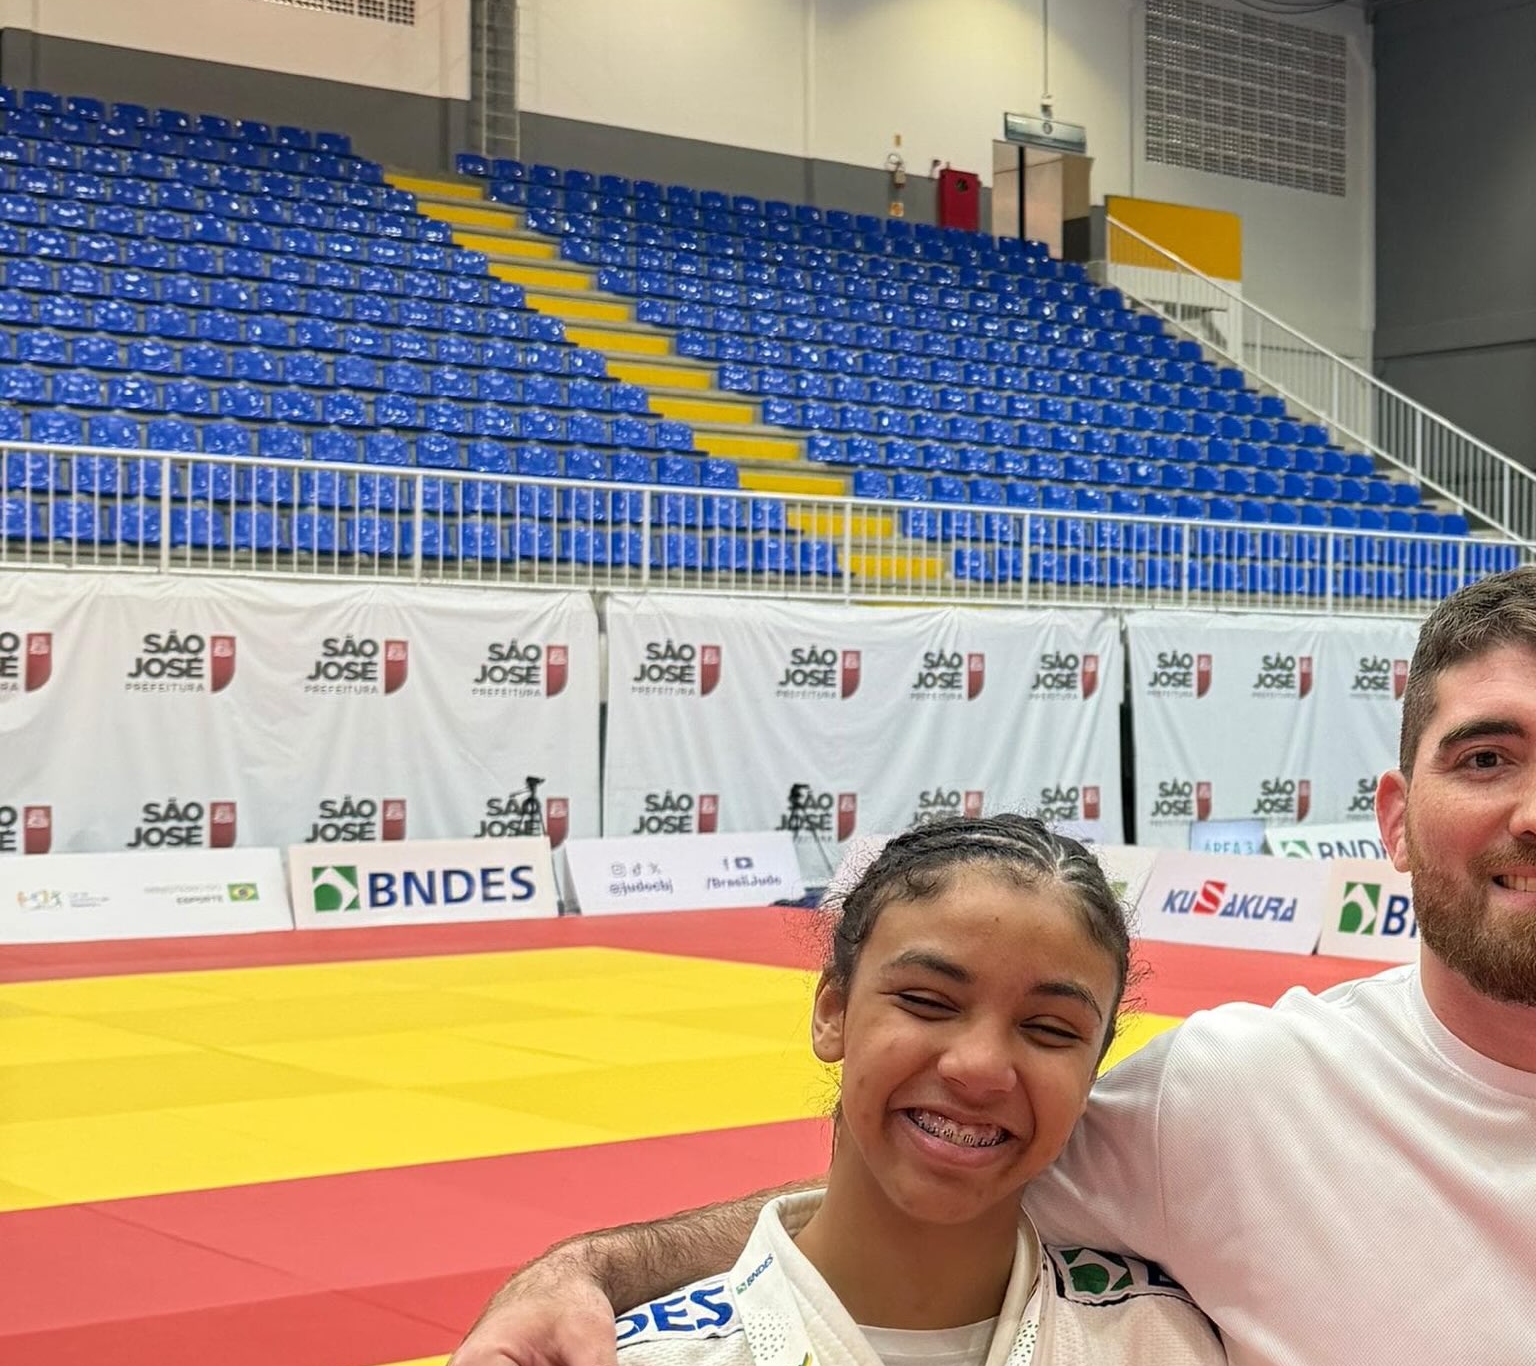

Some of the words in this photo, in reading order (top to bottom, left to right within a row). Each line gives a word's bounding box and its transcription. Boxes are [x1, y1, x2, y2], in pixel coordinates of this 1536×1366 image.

[143, 630, 206, 654] SÃO
[322, 635, 379, 658] SÃO
[488, 640, 542, 663] SÃO
[646, 639, 696, 662] SÃO
[127, 656, 204, 679] JOSÉ
[791, 645, 838, 667] SÃO
[307, 660, 378, 681] JOSÉ
[474, 664, 541, 685] JOSÉ
[143, 798, 204, 823] SÃO
[319, 796, 377, 819] SÃO
[645, 791, 695, 813] SÃO
[305, 822, 376, 843] JOSÉ
[632, 814, 694, 835] JOSÉ
[126, 825, 203, 848] JOSÉ
[368, 865, 537, 909] BNDES
